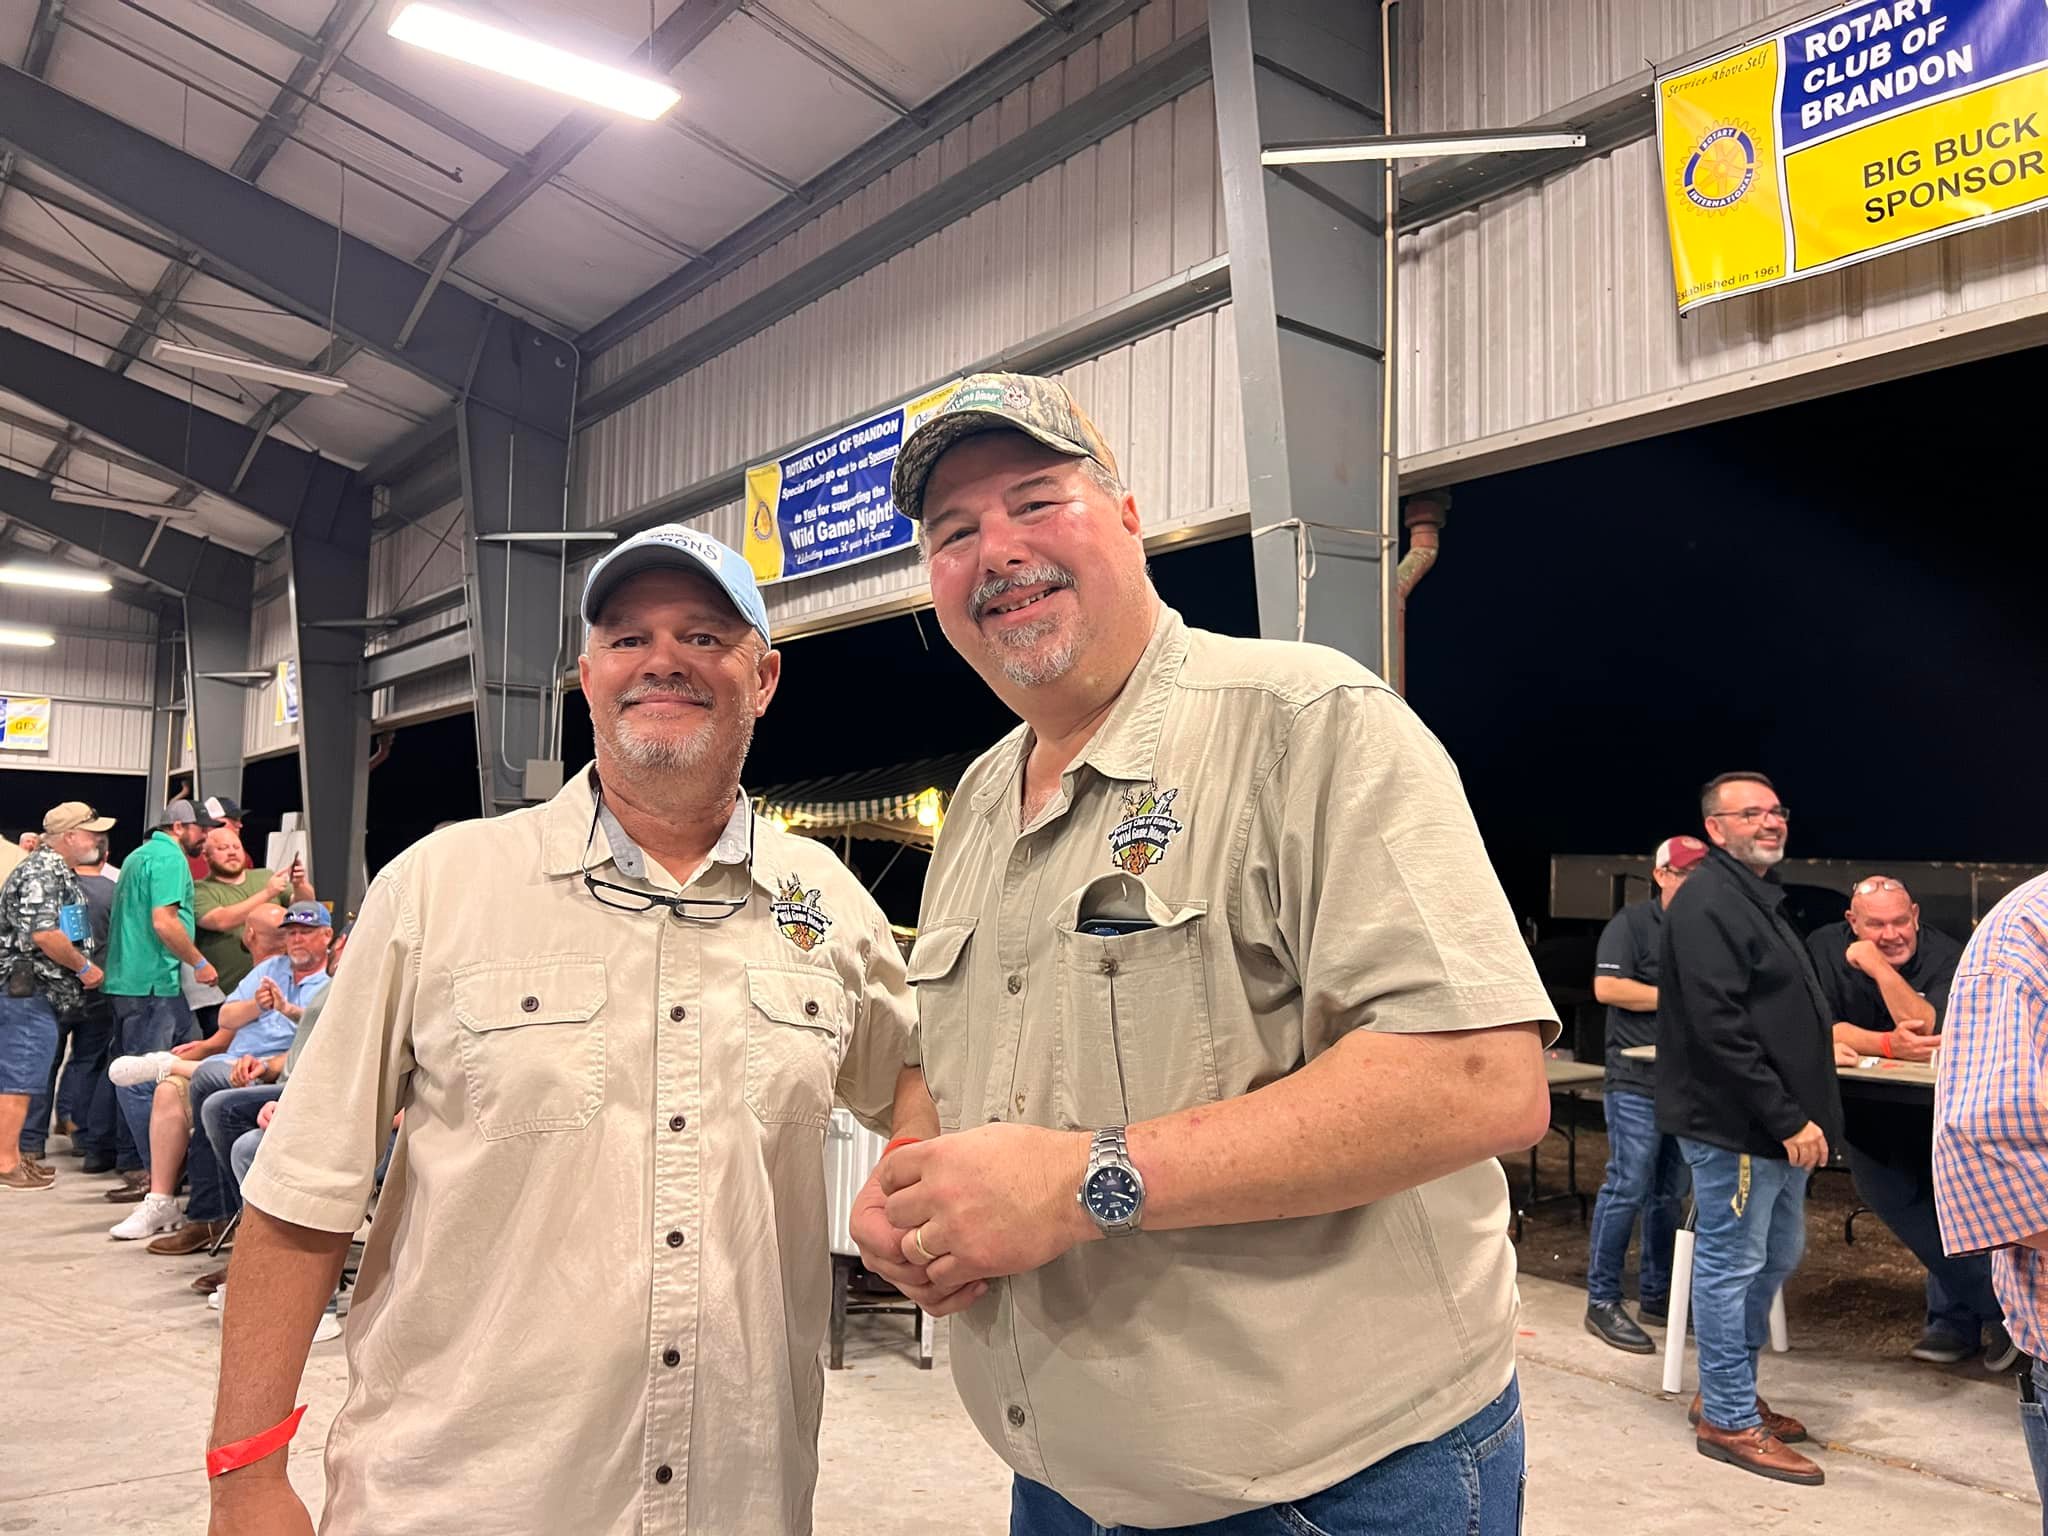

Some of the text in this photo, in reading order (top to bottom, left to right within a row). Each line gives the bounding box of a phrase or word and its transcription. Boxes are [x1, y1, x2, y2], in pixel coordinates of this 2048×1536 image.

[1803, 15, 1948, 94] CLUB OF
[1804, 0, 1933, 63] ROTARY
[1667, 48, 1769, 98] Service Above Self
[1801, 43, 1974, 130] BRANDON
[1701, 128, 1735, 149] ROTARY
[1863, 111, 2041, 189] BIG BUCK
[1688, 172, 1753, 208] INTERNATIONAL
[1864, 149, 2046, 224] SPONSOR
[1738, 272, 1749, 282] in
[1754, 264, 1780, 279] 1961
[785, 454, 816, 479] ROTARY
[815, 443, 838, 466] CLUB
[839, 437, 852, 454] OF
[852, 418, 900, 448] BRANDON
[781, 482, 806, 501] Special
[825, 470, 836, 483] go
[836, 464, 850, 477] out
[850, 461, 857, 472] to
[794, 485, 886, 524] to You for supporting the
[831, 480, 848, 496] and
[789, 524, 815, 550] Wild
[816, 517, 856, 542] Game
[856, 501, 894, 531] Night!
